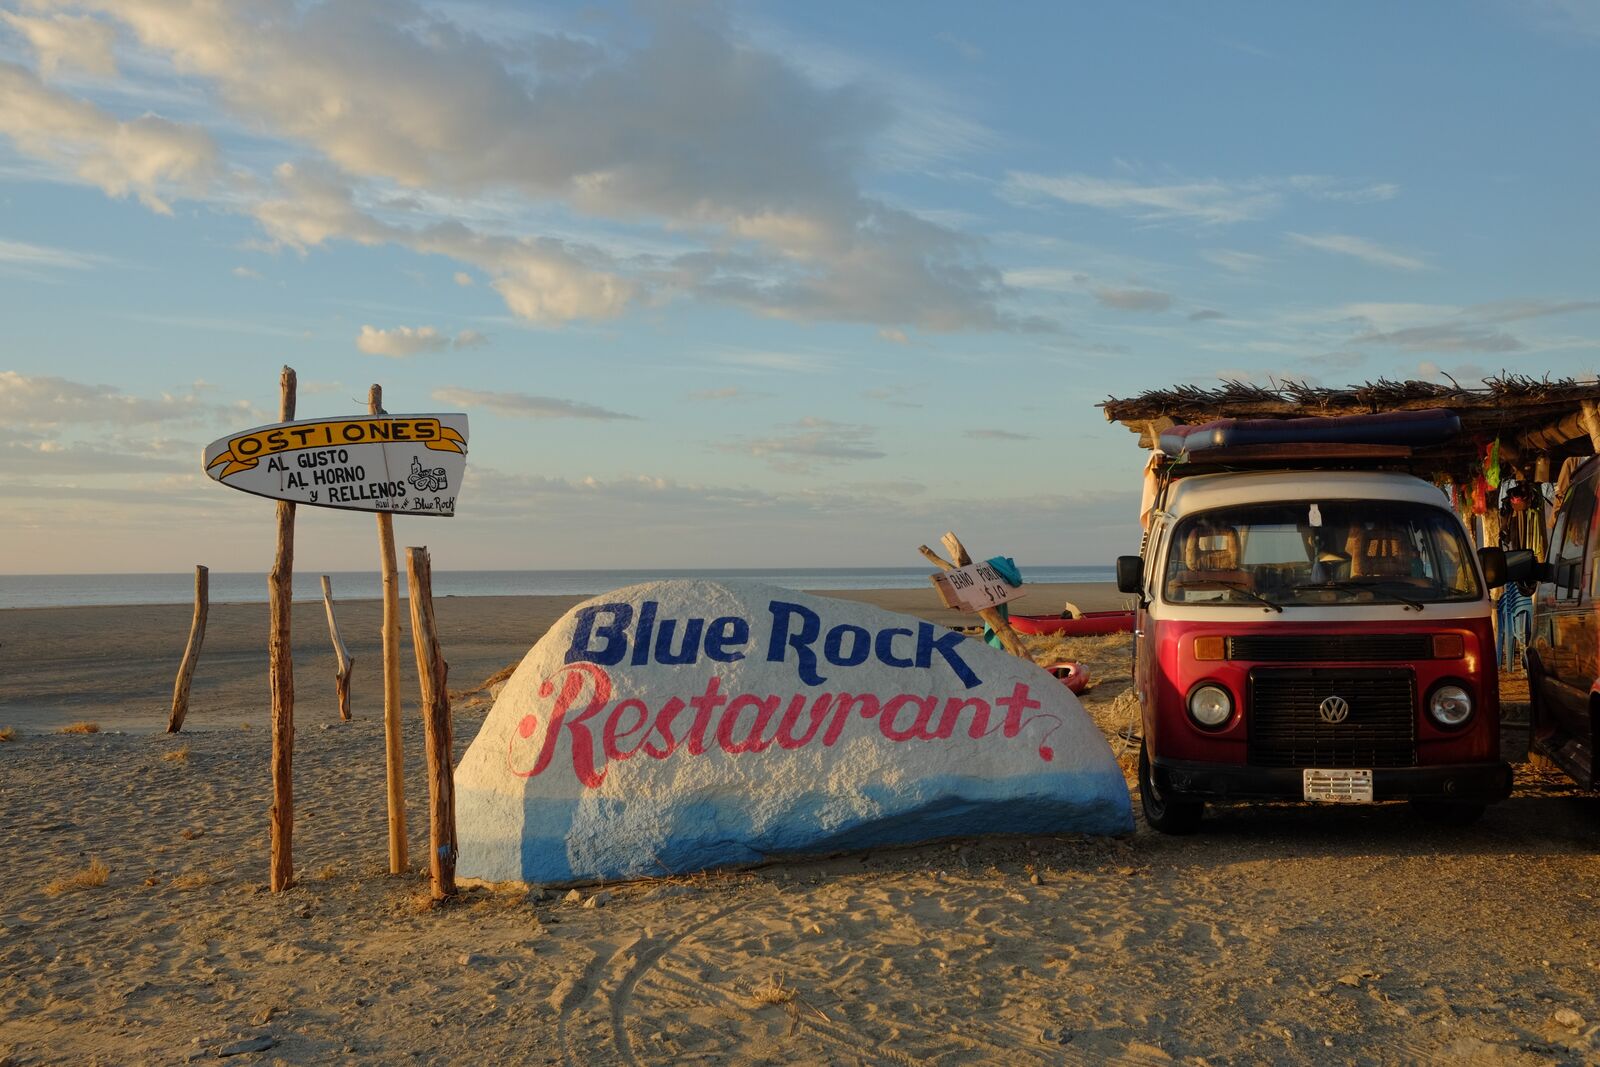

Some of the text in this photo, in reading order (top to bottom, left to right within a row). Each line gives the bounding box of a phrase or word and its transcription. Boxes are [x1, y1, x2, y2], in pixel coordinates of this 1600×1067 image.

[238, 422, 435, 455] OSTIONES
[268, 449, 348, 473] AL GUSTO
[287, 465, 365, 489] AL HORNO
[328, 481, 406, 503] RELLENOS
[410, 497, 434, 511] Blue
[564, 601, 750, 667] Blue
[508, 661, 1063, 789] Restaurant
